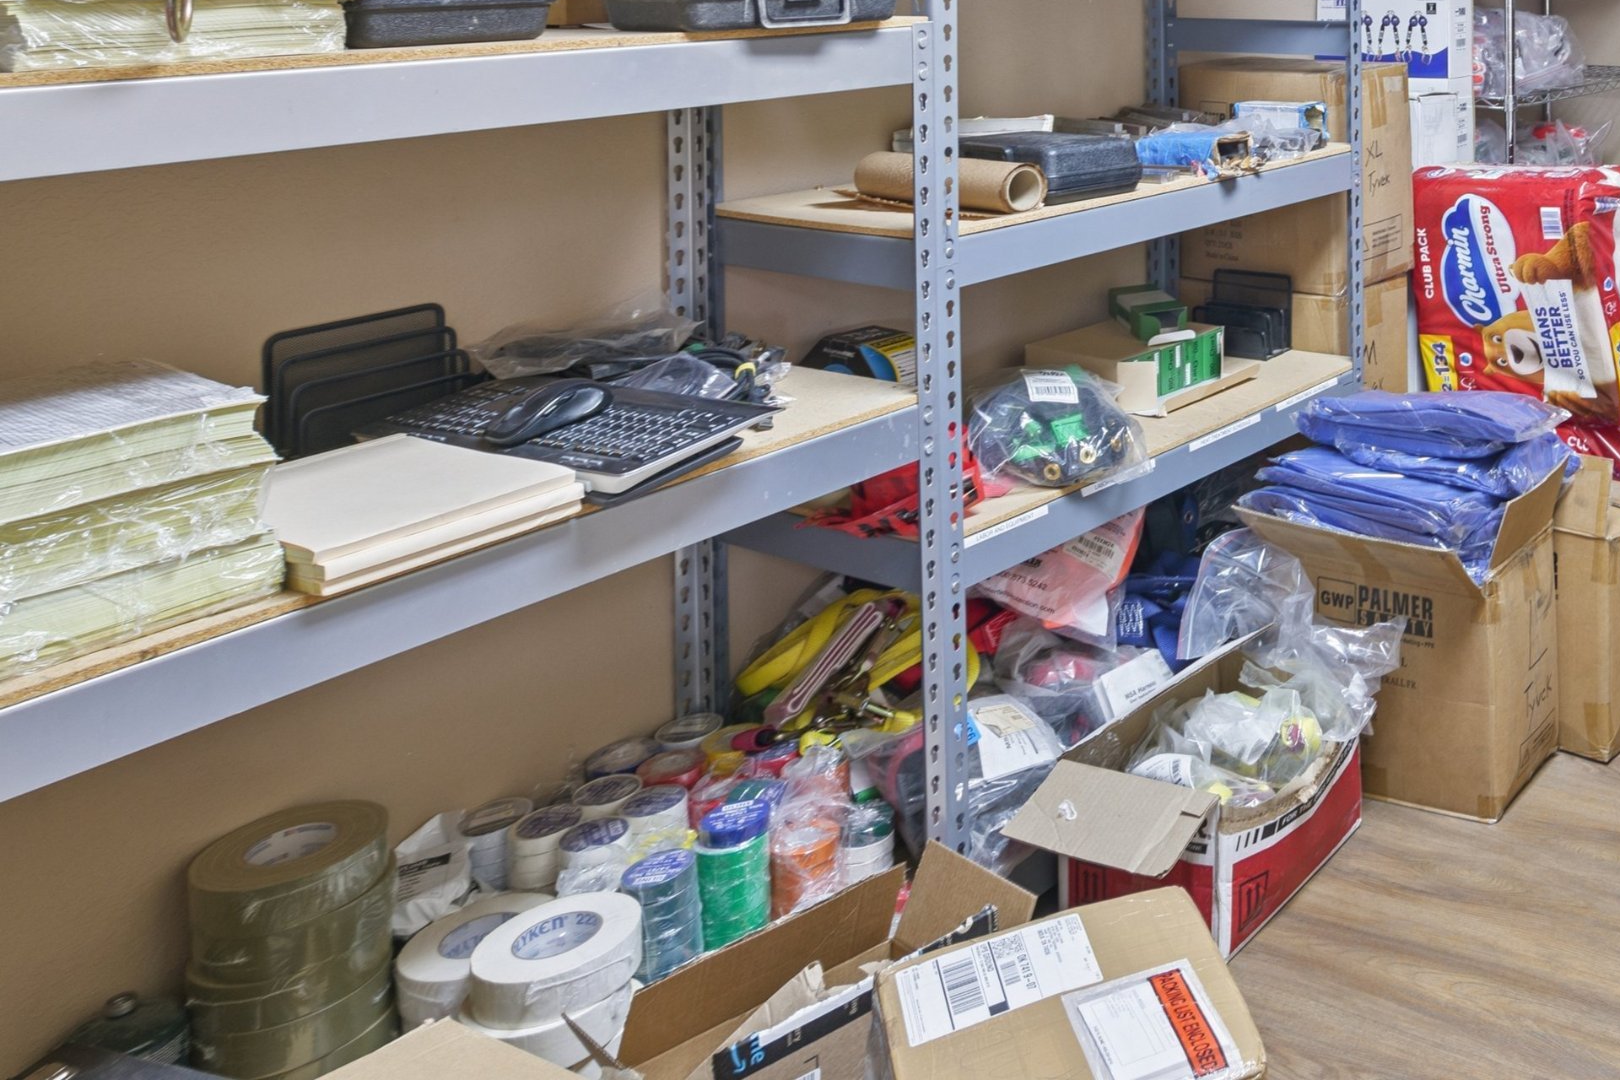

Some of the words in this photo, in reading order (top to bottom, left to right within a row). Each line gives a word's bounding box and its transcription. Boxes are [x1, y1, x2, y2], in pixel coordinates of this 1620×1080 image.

[1417, 228, 1429, 262] PACK
[1479, 205, 1500, 255] Strong
[1422, 266, 1435, 299] CLUB
[1447, 226, 1492, 322] Charmin
[1490, 257, 1511, 294] Ultra
[1560, 293, 1572, 312] LESS
[1535, 306, 1560, 368] CLEANS
[1550, 306, 1575, 368] BETTER
[1564, 313, 1575, 329] USE
[1568, 330, 1579, 348] CAN
[1573, 348, 1582, 367] YOU
[1578, 369, 1585, 380] SO
[1321, 590, 1354, 609] GWP
[1358, 585, 1433, 621] PALMER
[1159, 971, 1186, 1006] PACKING
[1174, 1002, 1196, 1024] LIST
[1183, 1019, 1217, 1071] ENCLOSED
